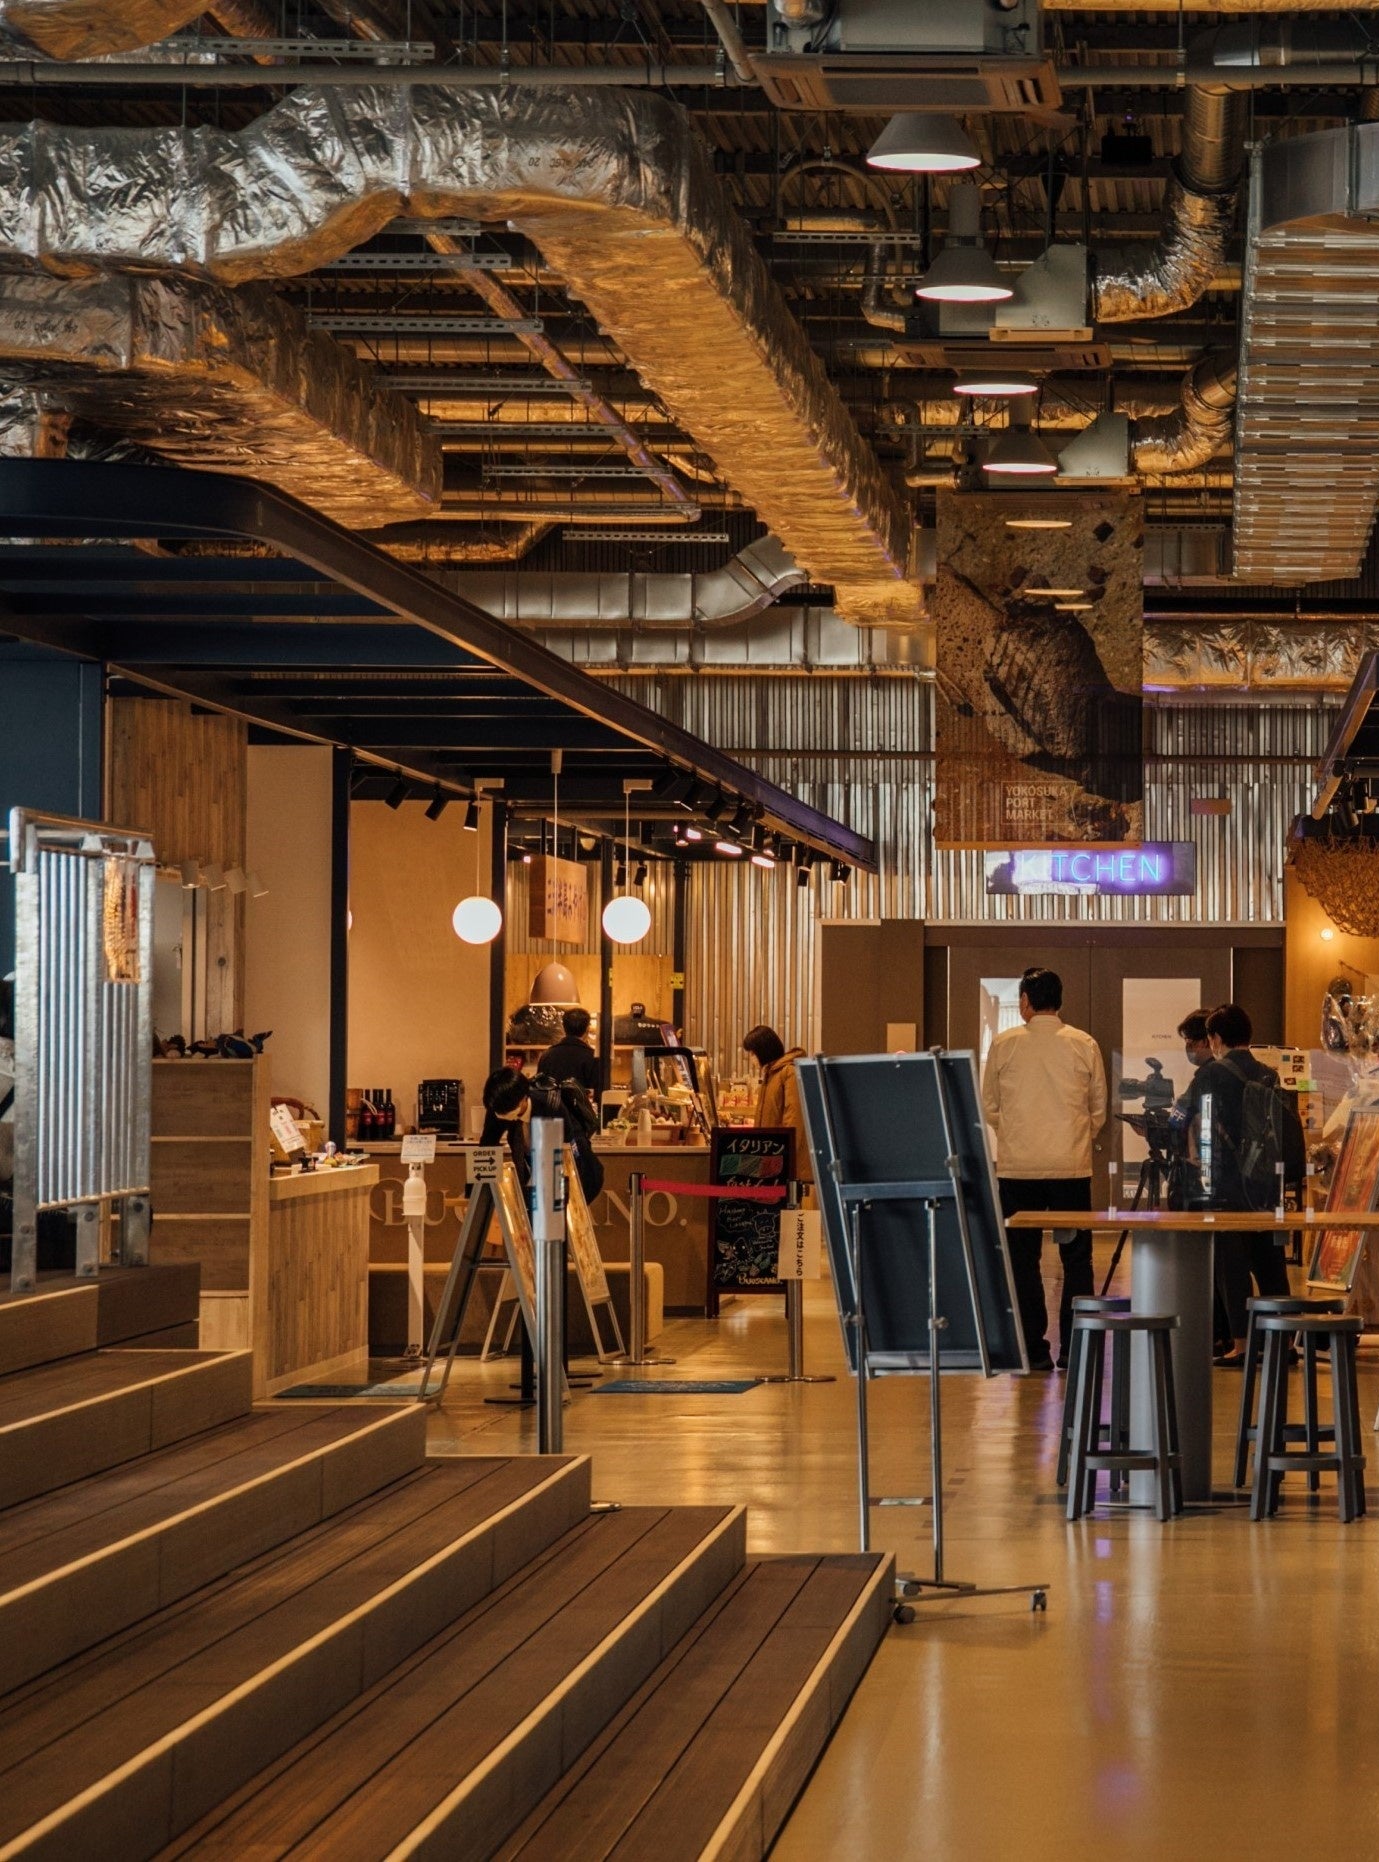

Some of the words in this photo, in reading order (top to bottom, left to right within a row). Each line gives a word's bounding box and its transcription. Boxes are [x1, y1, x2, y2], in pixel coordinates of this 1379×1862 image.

[1006, 786, 1068, 797] YOKOSUKA
[1006, 798, 1035, 809] PORT
[1006, 810, 1054, 821] MARKET
[726, 1138, 785, 1155] イタリアン
[796, 1213, 806, 1277] ご注文はこちら
